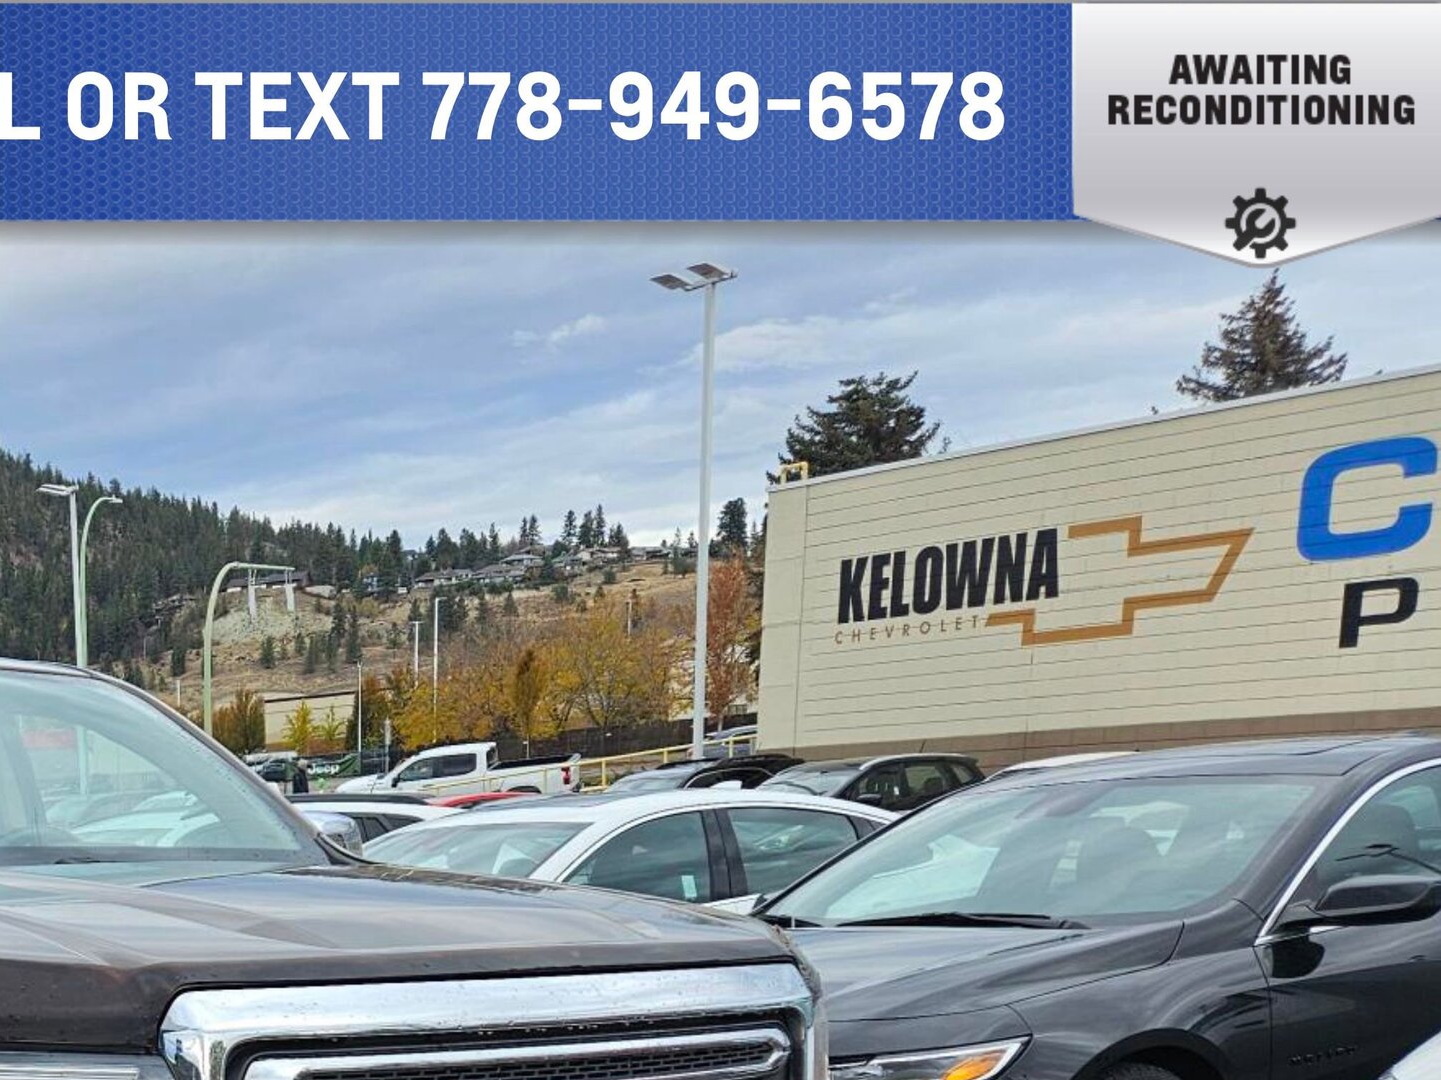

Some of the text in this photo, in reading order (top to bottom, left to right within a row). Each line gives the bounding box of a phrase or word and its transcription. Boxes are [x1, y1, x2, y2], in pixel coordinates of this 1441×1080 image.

[837, 528, 1060, 625] KELOWNA
[834, 614, 980, 645] CHEVROLET
[307, 762, 340, 775] Jeep
